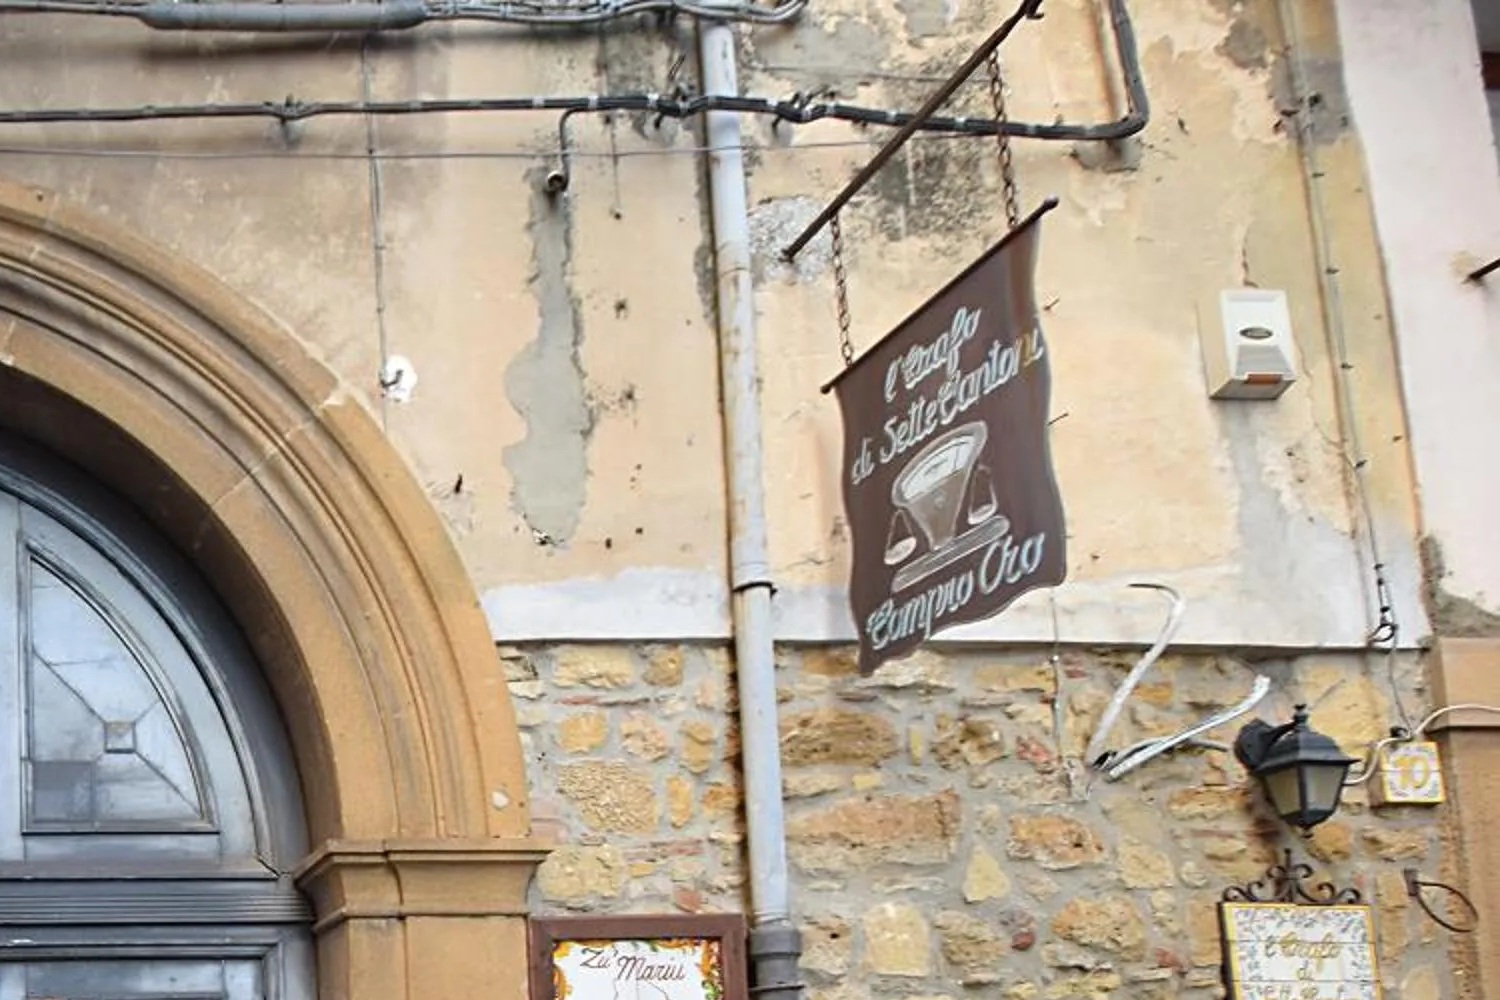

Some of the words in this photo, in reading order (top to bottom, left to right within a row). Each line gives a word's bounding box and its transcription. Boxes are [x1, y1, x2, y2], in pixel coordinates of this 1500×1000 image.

[852, 437, 875, 485] di
[866, 569, 975, 650] Compro
[978, 532, 1046, 595] Oro
[1395, 754, 1430, 790] 10
